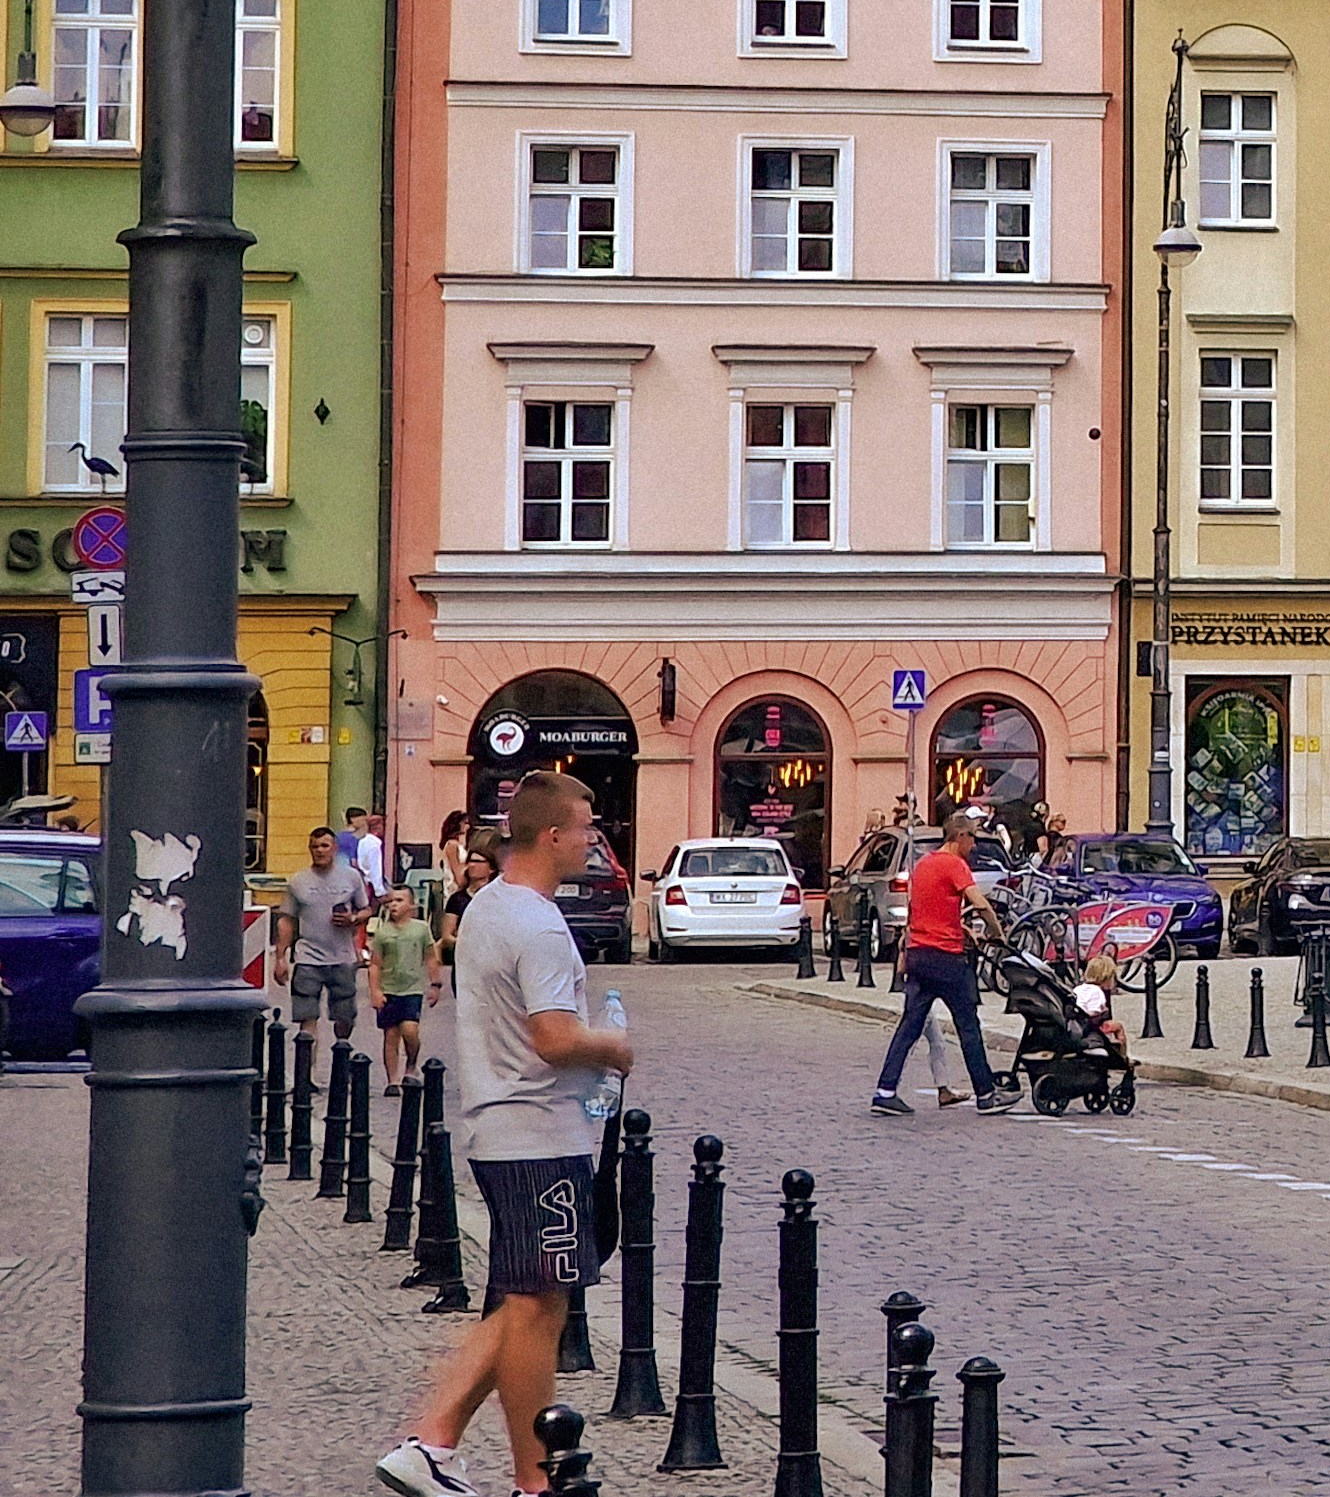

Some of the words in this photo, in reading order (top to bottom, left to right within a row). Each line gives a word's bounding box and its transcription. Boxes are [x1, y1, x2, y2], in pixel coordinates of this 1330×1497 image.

[1170, 626, 1330, 647] PRZYSTANEK
[539, 731, 628, 743] MOABURGER
[539, 1179, 580, 1283] FILA
